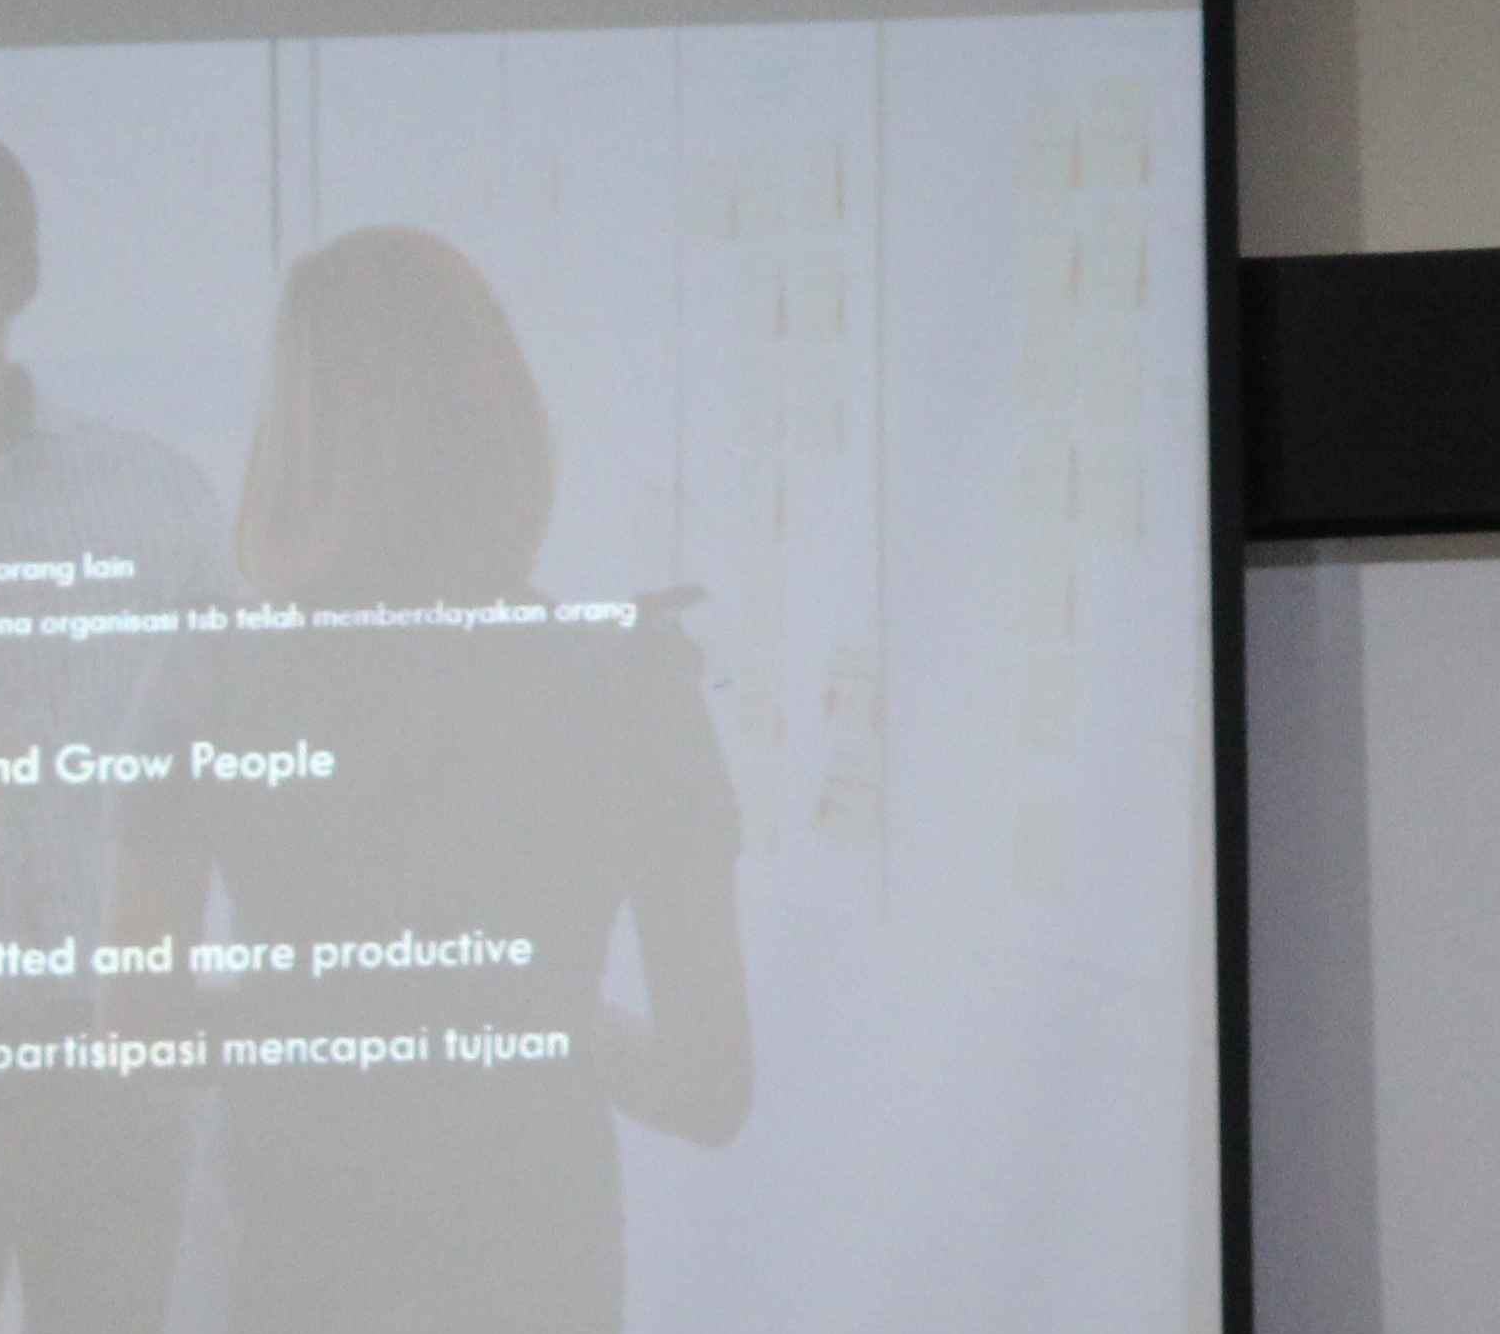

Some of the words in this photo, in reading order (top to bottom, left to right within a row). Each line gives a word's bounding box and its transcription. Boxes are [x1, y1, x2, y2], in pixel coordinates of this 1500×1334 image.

[83, 553, 134, 579] lain
[40, 611, 177, 641] organisasi
[236, 603, 305, 630] telah
[312, 599, 545, 630] memberdayakan
[555, 601, 637, 628] orang
[56, 745, 173, 783] Grow
[191, 741, 336, 787] People
[92, 936, 172, 973] and
[189, 942, 296, 973] more
[312, 931, 532, 978] productive
[222, 1028, 428, 1071] mencapai
[444, 1028, 569, 1070] tujuan
